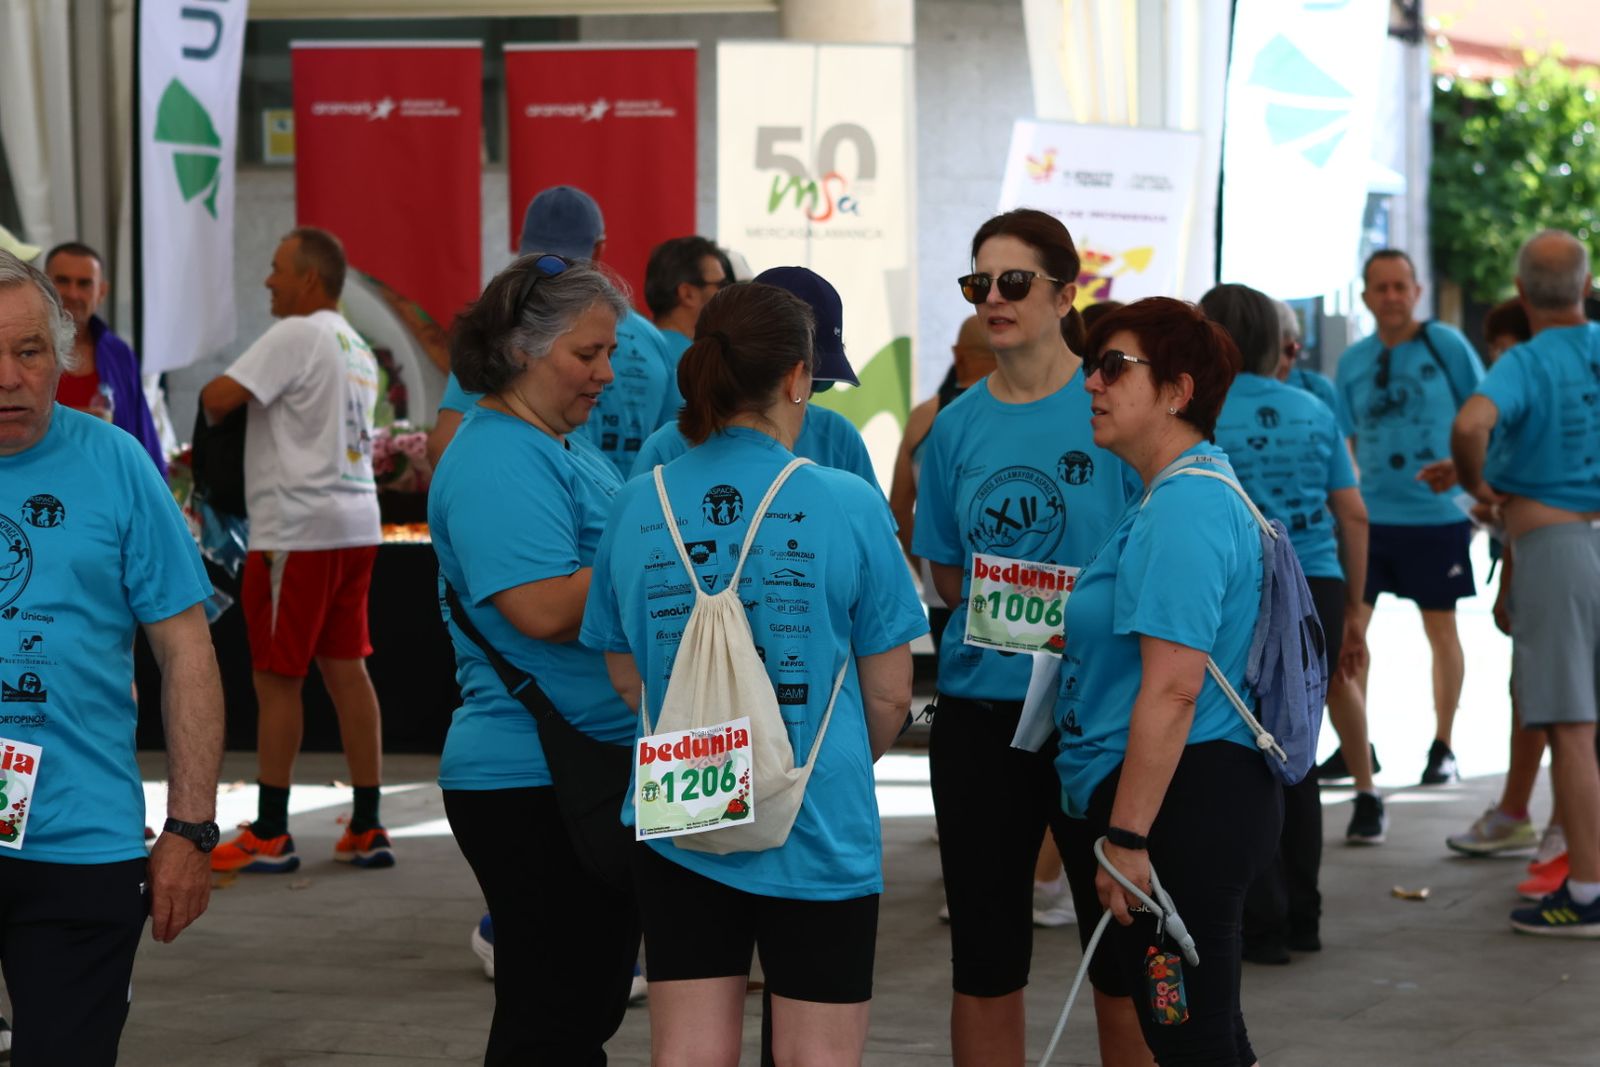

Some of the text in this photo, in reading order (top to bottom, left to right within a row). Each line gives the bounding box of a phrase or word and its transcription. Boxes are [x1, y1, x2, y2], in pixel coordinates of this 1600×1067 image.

[755, 122, 876, 183] 50
[763, 510, 792, 521] amark
[985, 495, 1037, 535] XII
[793, 579, 816, 589] Bueno
[974, 557, 1076, 593] bedunia
[20, 611, 55, 624] Unicaja
[987, 590, 1063, 628] 1006
[769, 623, 812, 633] GLOBALIA
[0, 714, 47, 725] ORTOPINOS
[0, 745, 35, 776] ia
[639, 726, 749, 767] bedunia
[660, 759, 737, 804] 1206
